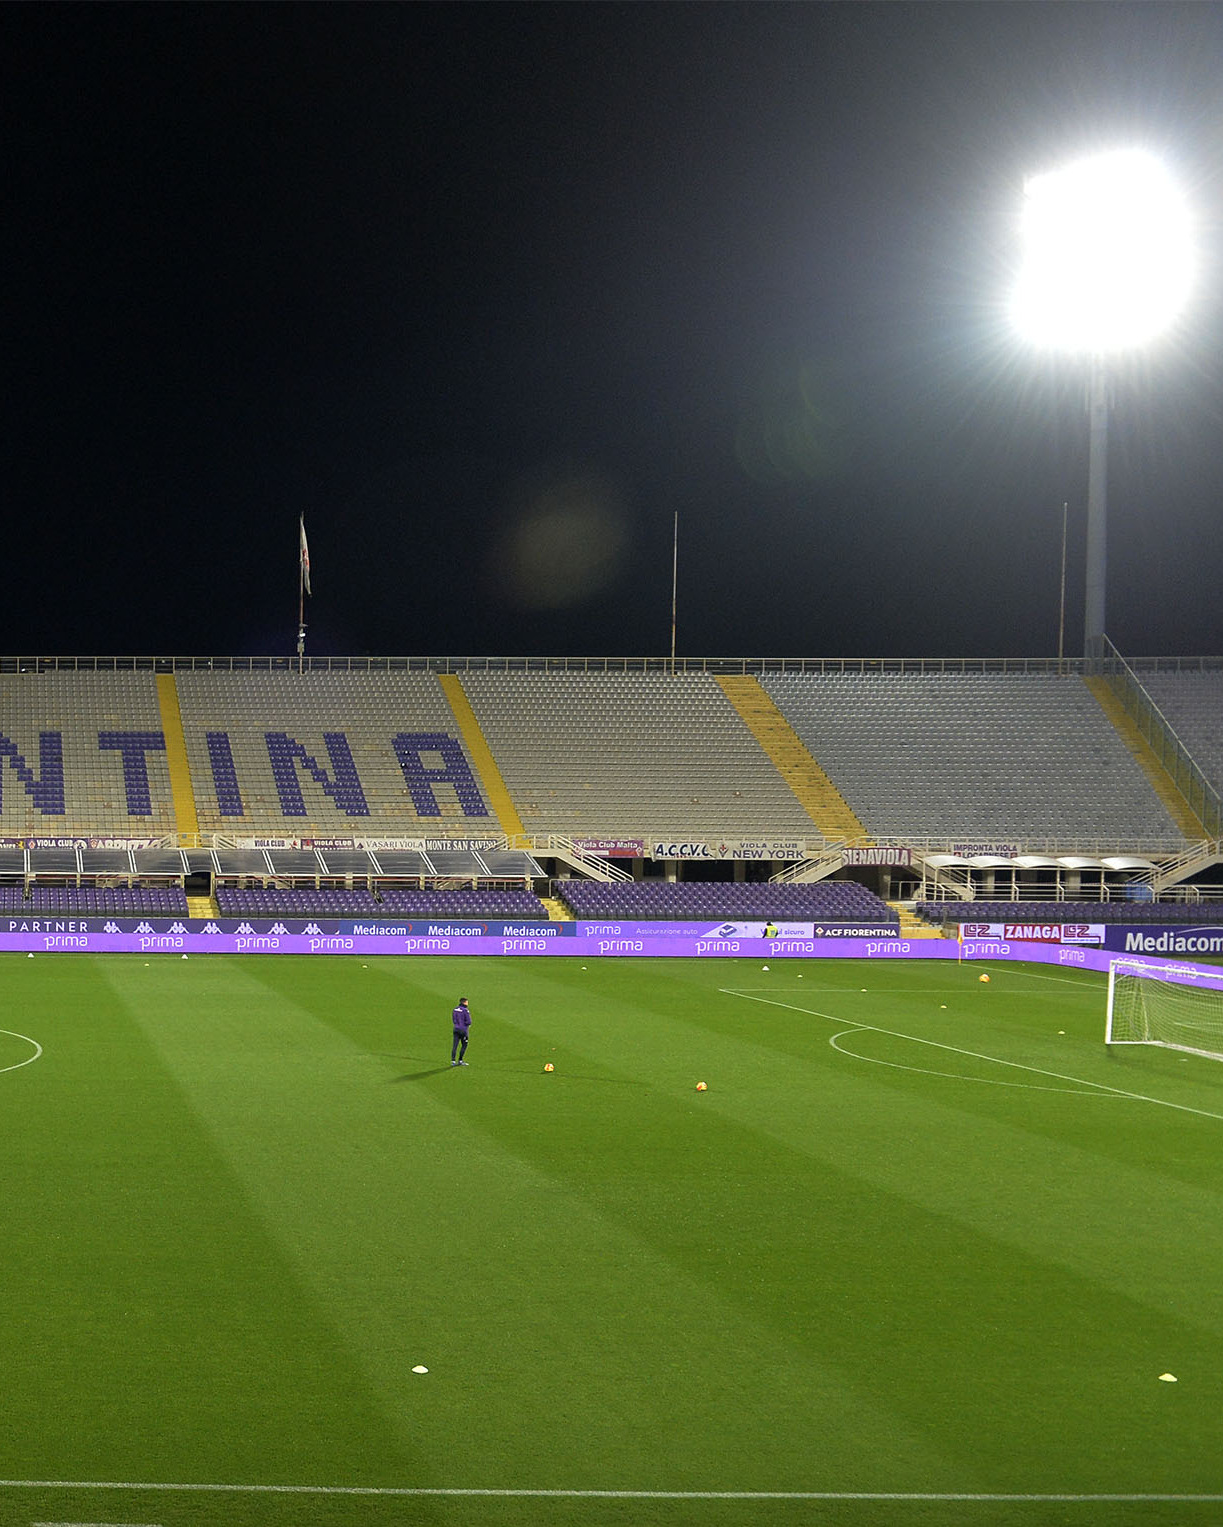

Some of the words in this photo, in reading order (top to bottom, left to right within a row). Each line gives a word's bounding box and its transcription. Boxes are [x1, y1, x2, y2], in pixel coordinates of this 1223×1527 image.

[37, 839, 56, 847] VIOLA
[58, 839, 73, 847] CLUB
[426, 840, 451, 850] MONTE
[453, 840, 468, 850] SAN
[733, 850, 763, 858] NEW
[767, 850, 804, 858] YORK
[9, 921, 88, 932] PARTNER
[585, 925, 621, 937] prima
[844, 929, 897, 937] FIORENTINA
[1005, 926, 1060, 938] ZANAGA
[43, 935, 88, 949] prima
[139, 936, 184, 950] prima
[235, 937, 280, 951] prima
[308, 938, 354, 952] prima
[405, 938, 450, 952] prima
[501, 939, 547, 953] prima
[598, 940, 643, 954] prima
[695, 940, 740, 954] prima
[769, 941, 814, 955] prima
[865, 942, 910, 956] prima
[1125, 932, 1223, 952] Mediacom
[963, 943, 1010, 957] prima
[1059, 949, 1085, 962] prima
